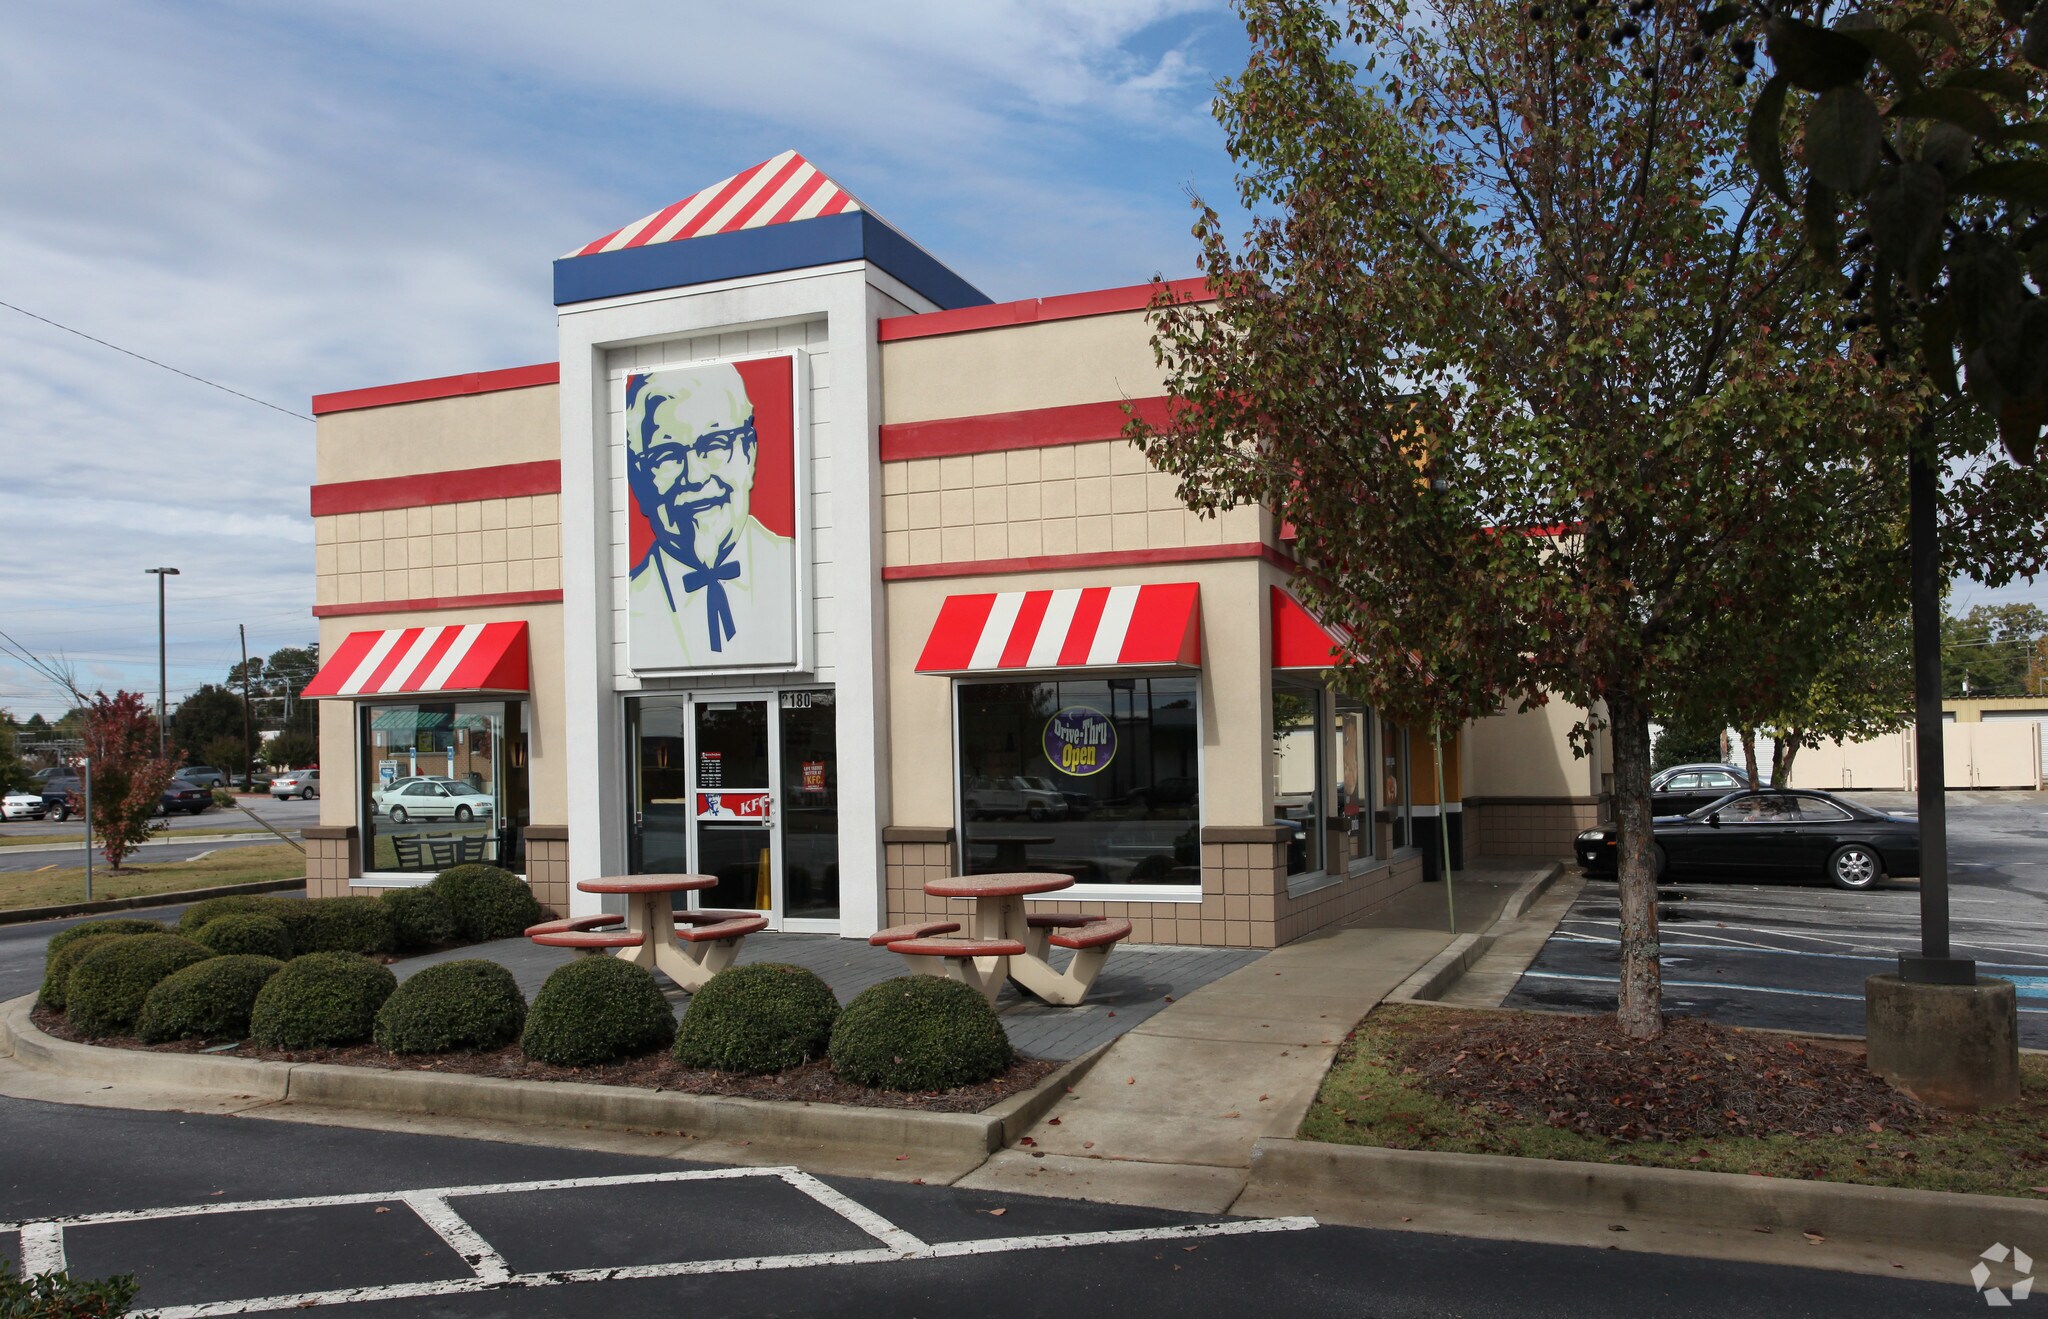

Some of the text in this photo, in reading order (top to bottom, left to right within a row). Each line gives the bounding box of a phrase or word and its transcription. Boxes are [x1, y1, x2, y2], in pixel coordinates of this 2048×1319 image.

[1054, 717, 1107, 745] Drive-Thru
[1062, 743, 1096, 772] Open
[740, 794, 769, 815] KFC
